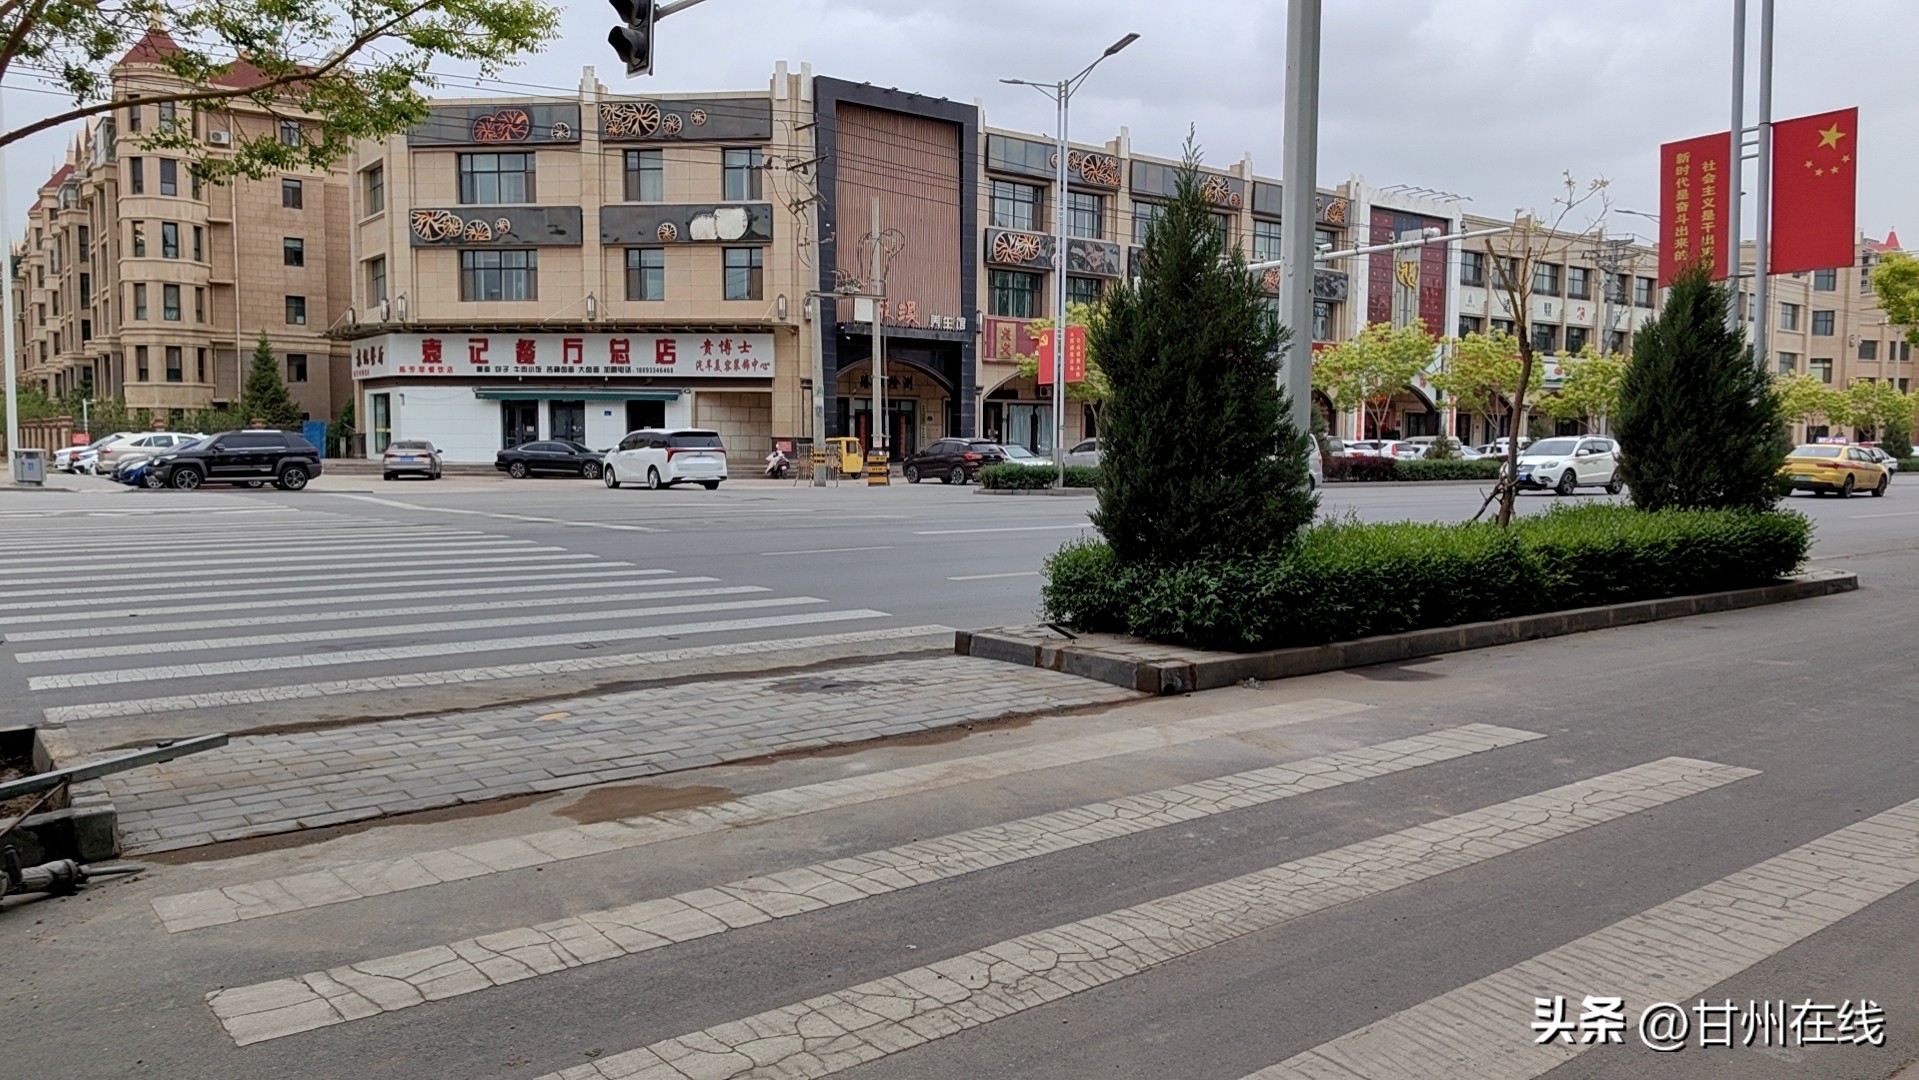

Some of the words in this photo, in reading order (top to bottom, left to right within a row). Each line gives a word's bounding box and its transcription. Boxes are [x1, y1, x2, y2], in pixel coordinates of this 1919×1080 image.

[1674, 151, 1691, 261] 新时代是奋斗出来的
[1700, 159, 1717, 270] 社会主义是干出来的
[930, 314, 967, 330] 养生馆
[422, 338, 677, 364] 袁记餐厅总店
[700, 338, 753, 356] 贵博士
[695, 358, 771, 372] 汽车美容装饰中心
